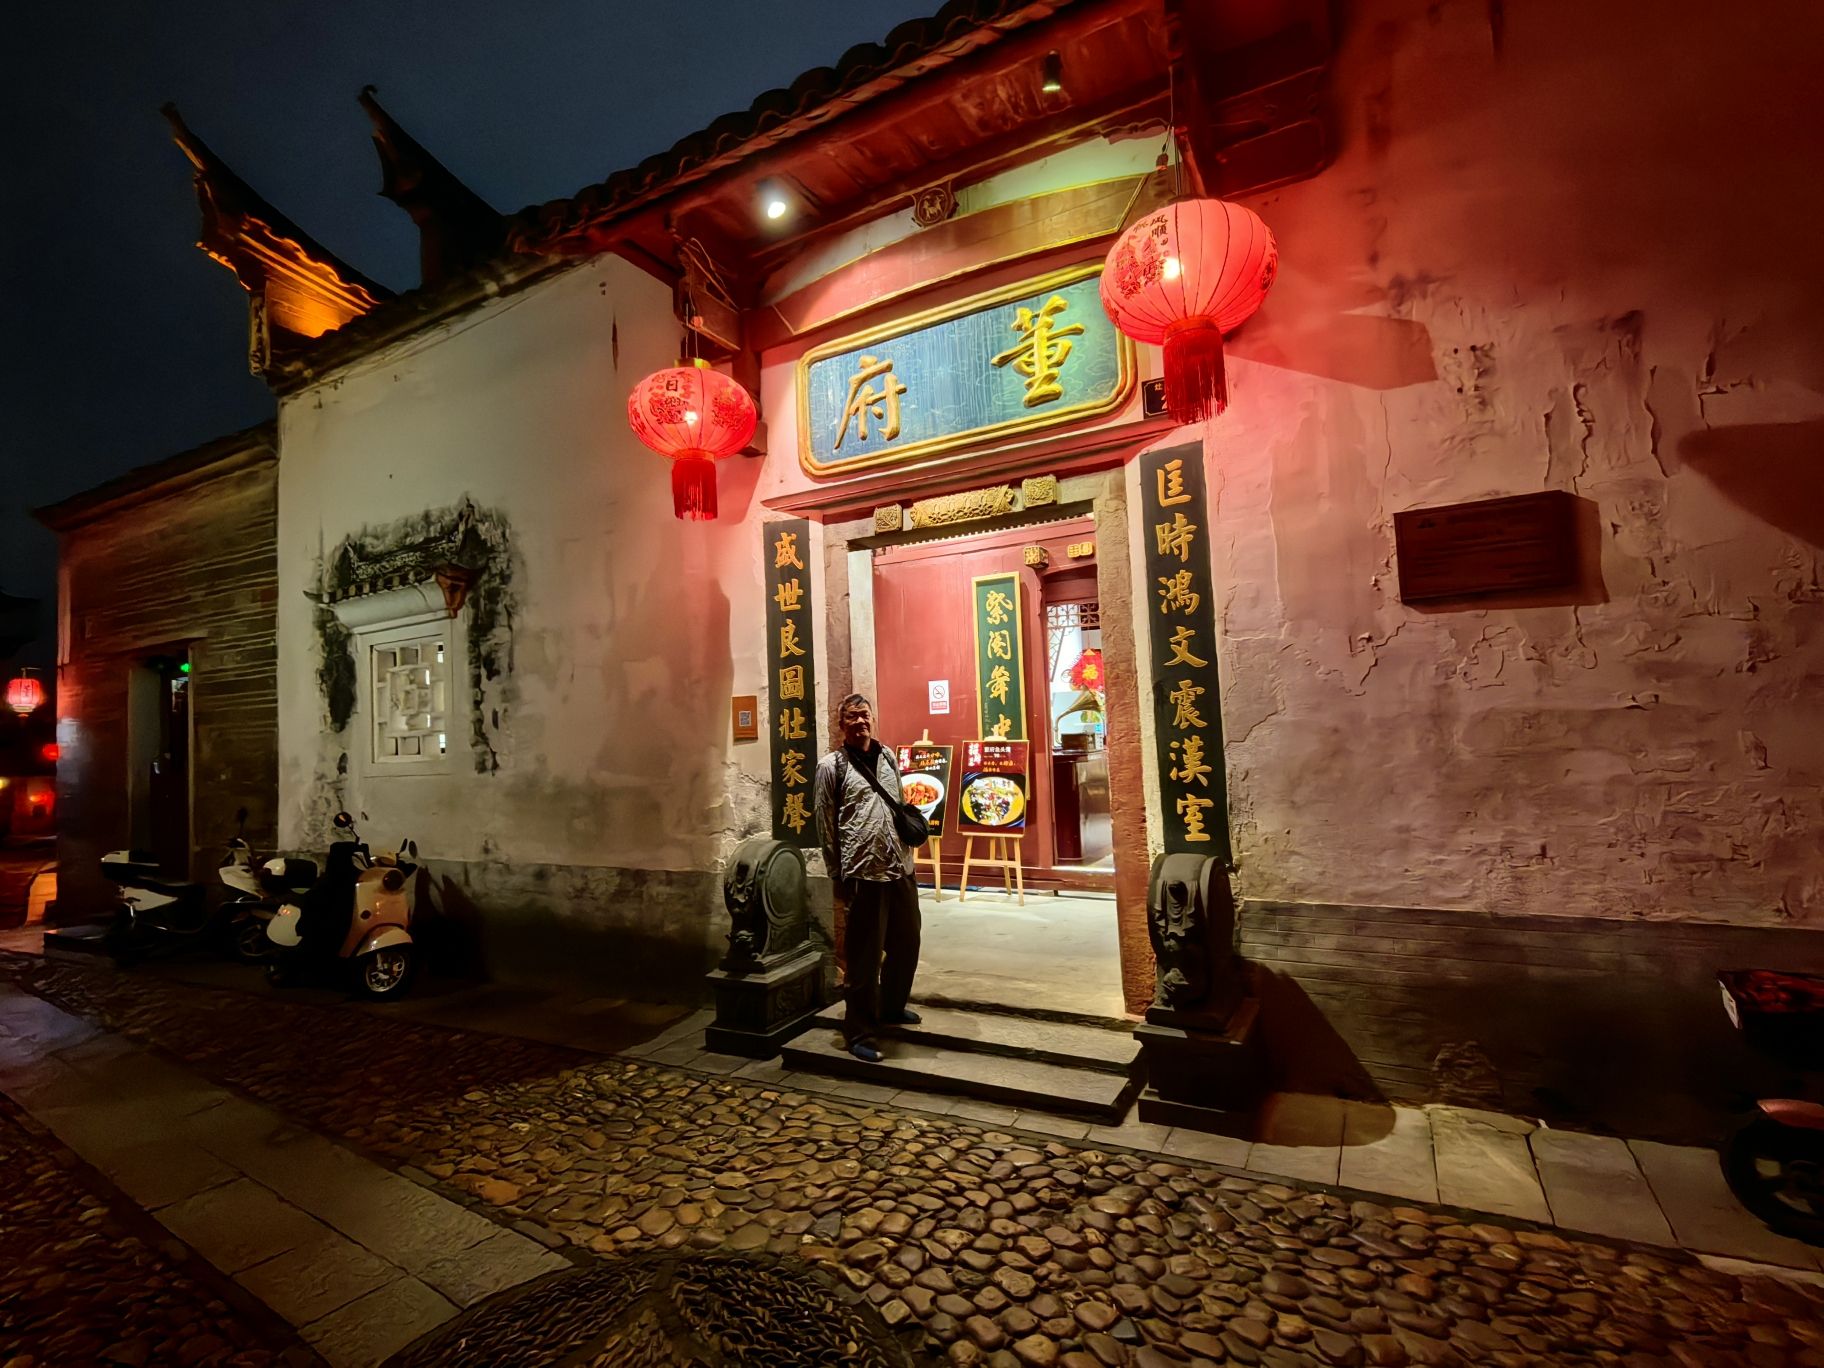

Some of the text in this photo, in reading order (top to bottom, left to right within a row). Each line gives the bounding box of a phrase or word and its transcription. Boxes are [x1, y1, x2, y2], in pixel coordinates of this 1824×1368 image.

[773, 531, 812, 835] 盛世良圖壯家聲
[1155, 458, 1214, 842] 匡時鴻文震漢室
